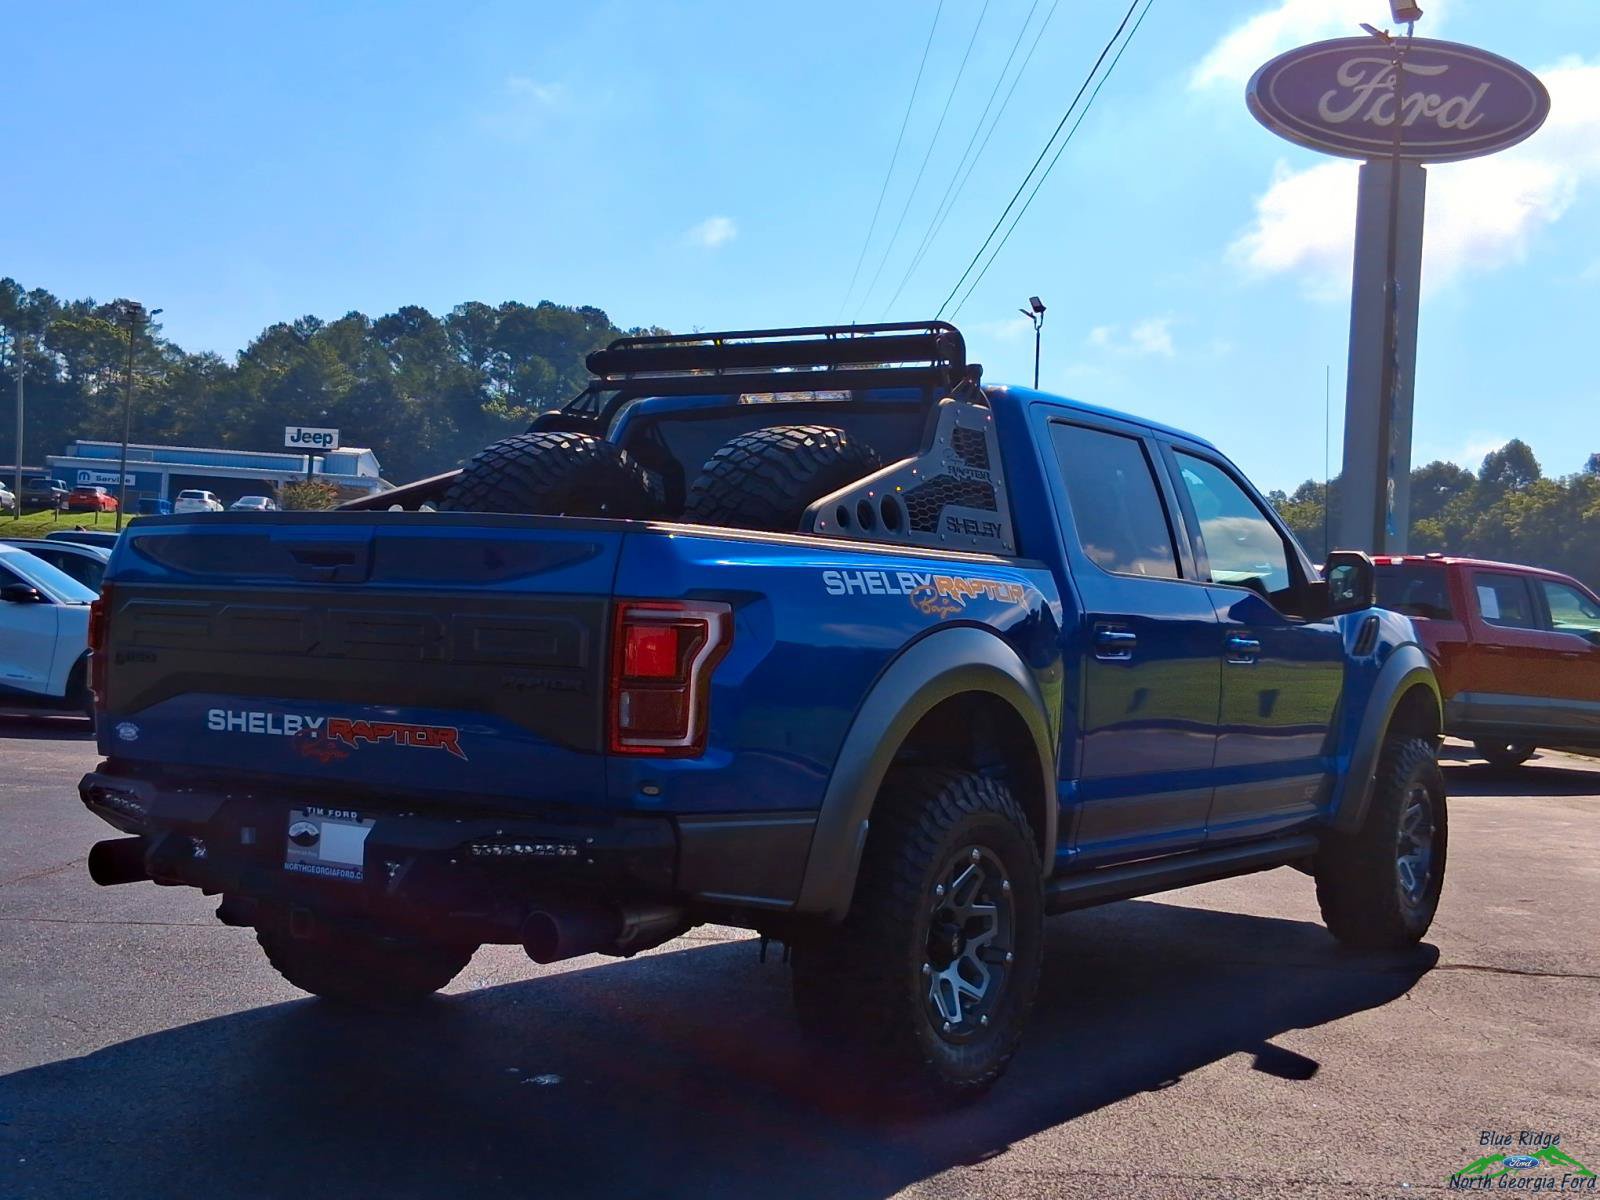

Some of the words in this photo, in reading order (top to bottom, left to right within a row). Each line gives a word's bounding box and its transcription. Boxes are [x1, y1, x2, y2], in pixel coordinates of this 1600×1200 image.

[1318, 57, 1491, 130] Ford
[290, 428, 333, 447] Jeep
[96, 474, 131, 484] Servie
[945, 516, 1002, 539] SHELBY
[822, 570, 932, 596] SHELBY
[932, 574, 1031, 615] RAPTOR
[207, 708, 326, 738] SHELBY
[327, 716, 470, 762] RAPTOR
[328, 809, 358, 819] FORD
